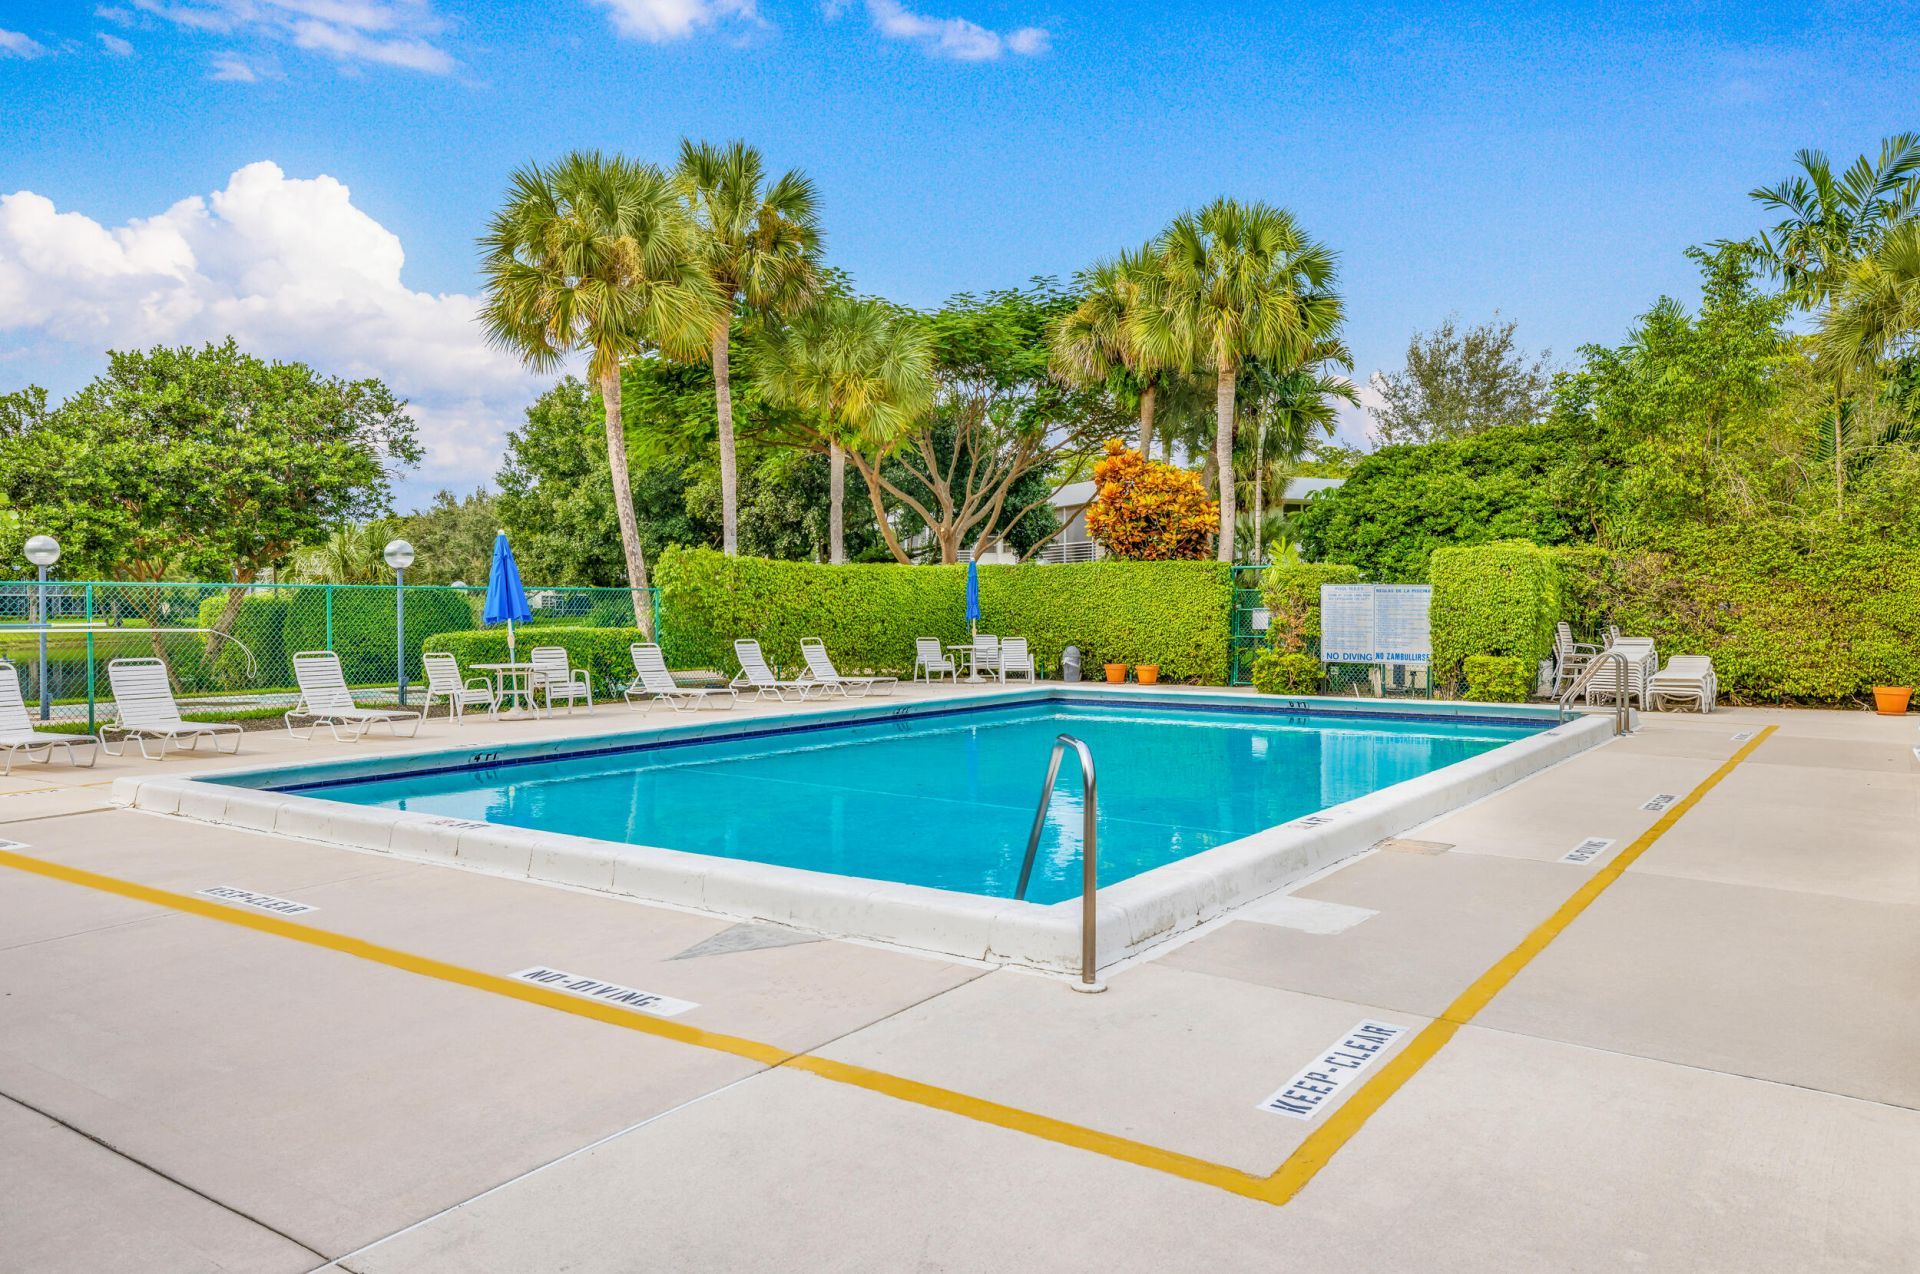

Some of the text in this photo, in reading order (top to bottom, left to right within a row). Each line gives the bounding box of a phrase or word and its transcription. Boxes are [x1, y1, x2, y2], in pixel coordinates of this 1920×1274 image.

[1326, 652, 1373, 661] NO DIVING
[1375, 652, 1384, 660] NO
[200, 886, 310, 914] KEEP-CLEAR
[522, 969, 663, 1007] NO-DIVING
[1269, 1025, 1398, 1115] KEEP-CLEAR
